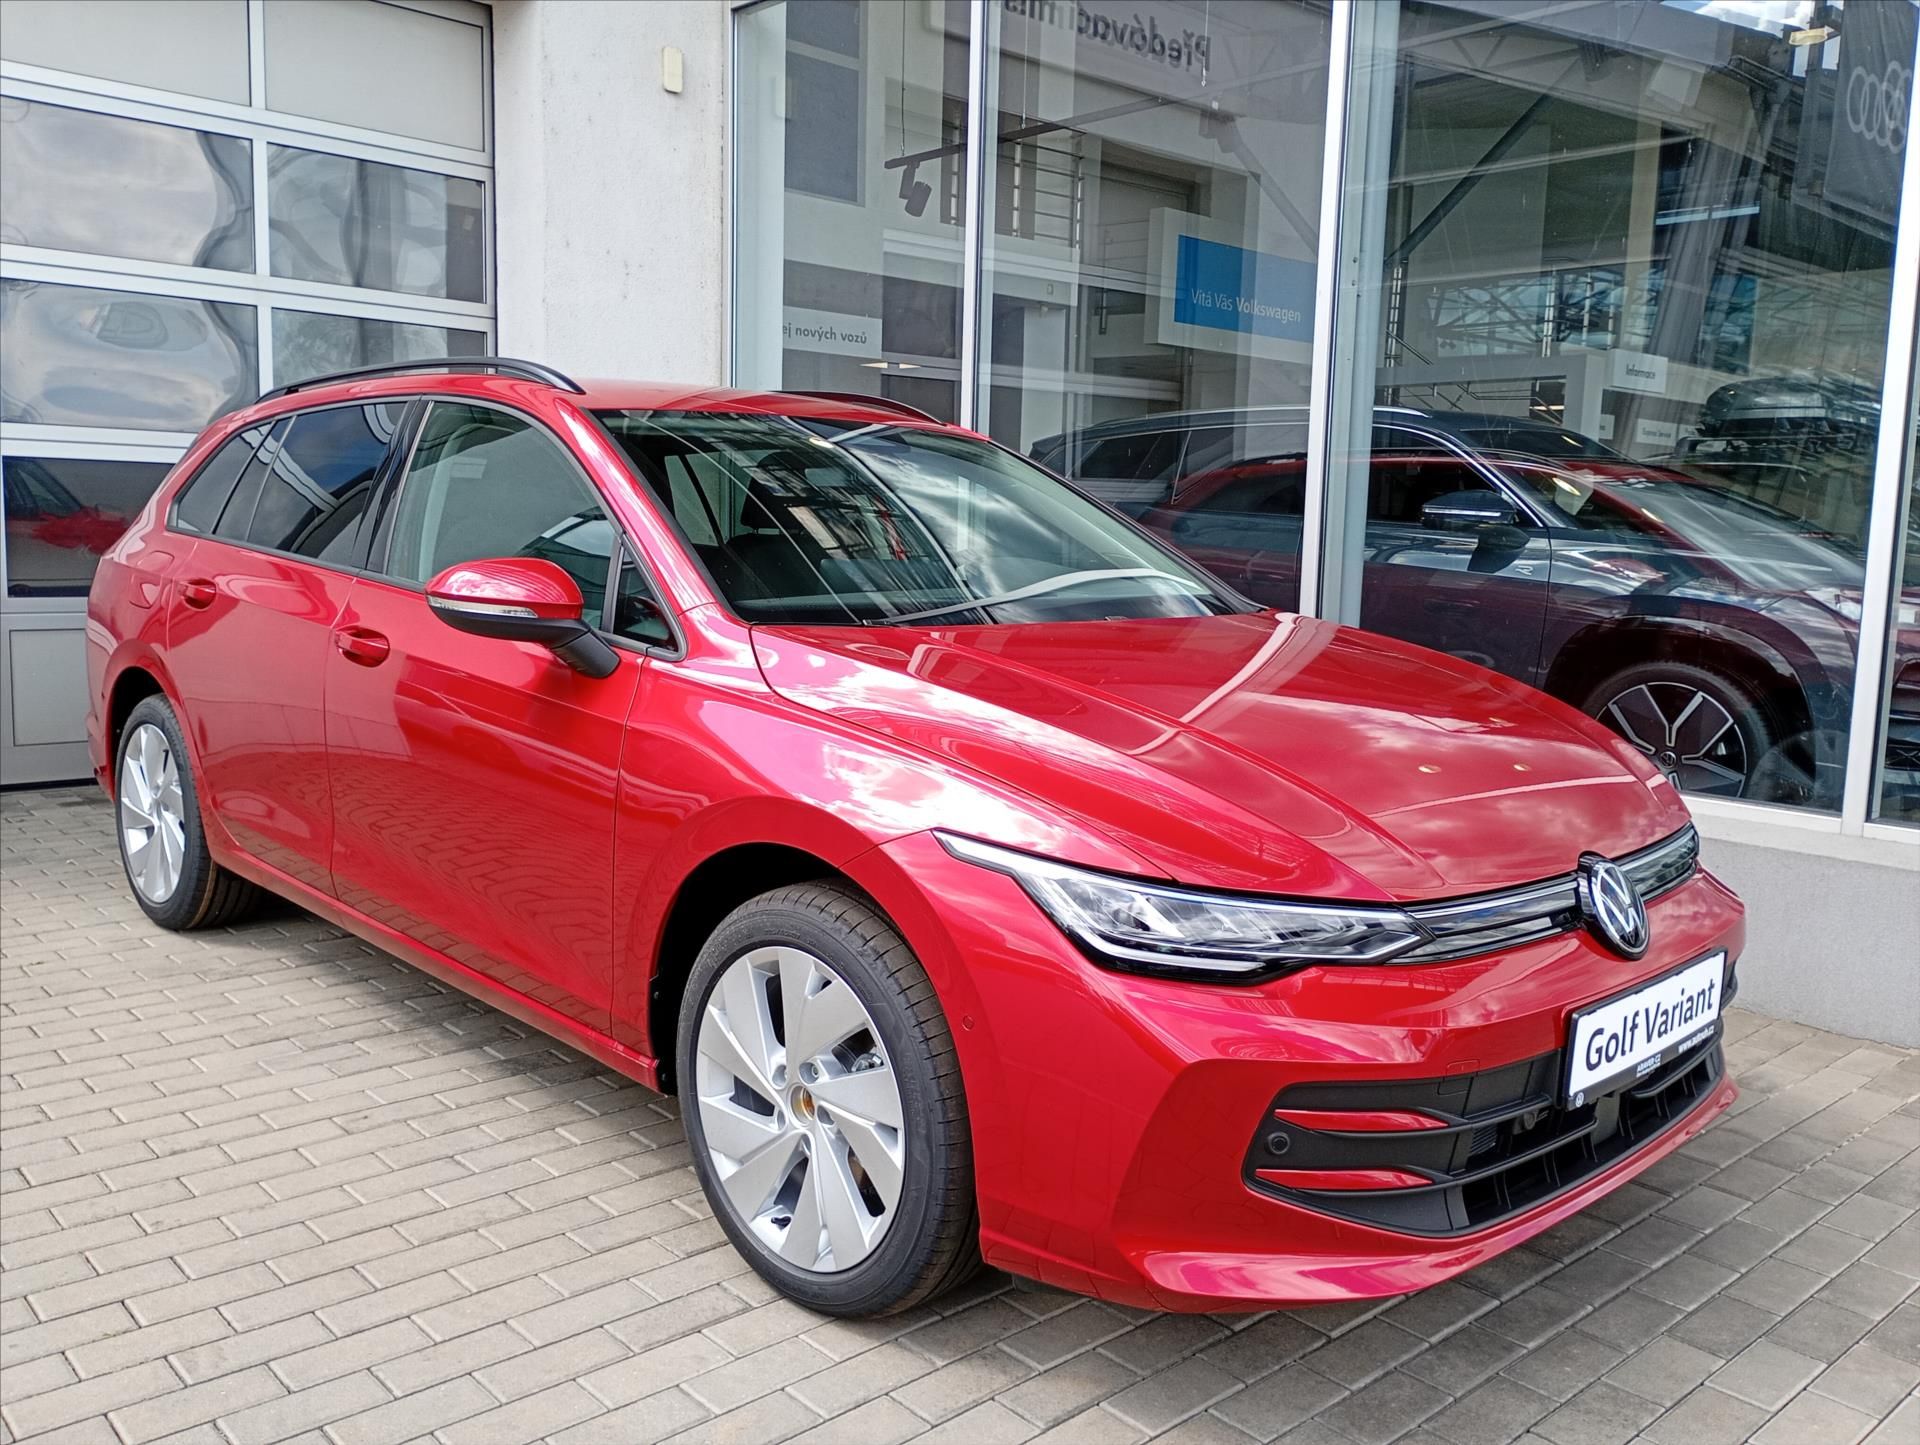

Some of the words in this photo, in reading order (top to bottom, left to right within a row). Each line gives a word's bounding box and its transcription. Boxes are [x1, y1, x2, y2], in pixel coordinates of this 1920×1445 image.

[1215, 292, 1233, 311] Vás
[1236, 296, 1301, 324] Volkswagen
[795, 326, 837, 342] nových
[840, 331, 867, 344] vozů
[1585, 1010, 1640, 1071] Golf
[1645, 978, 1715, 1044] Variant
